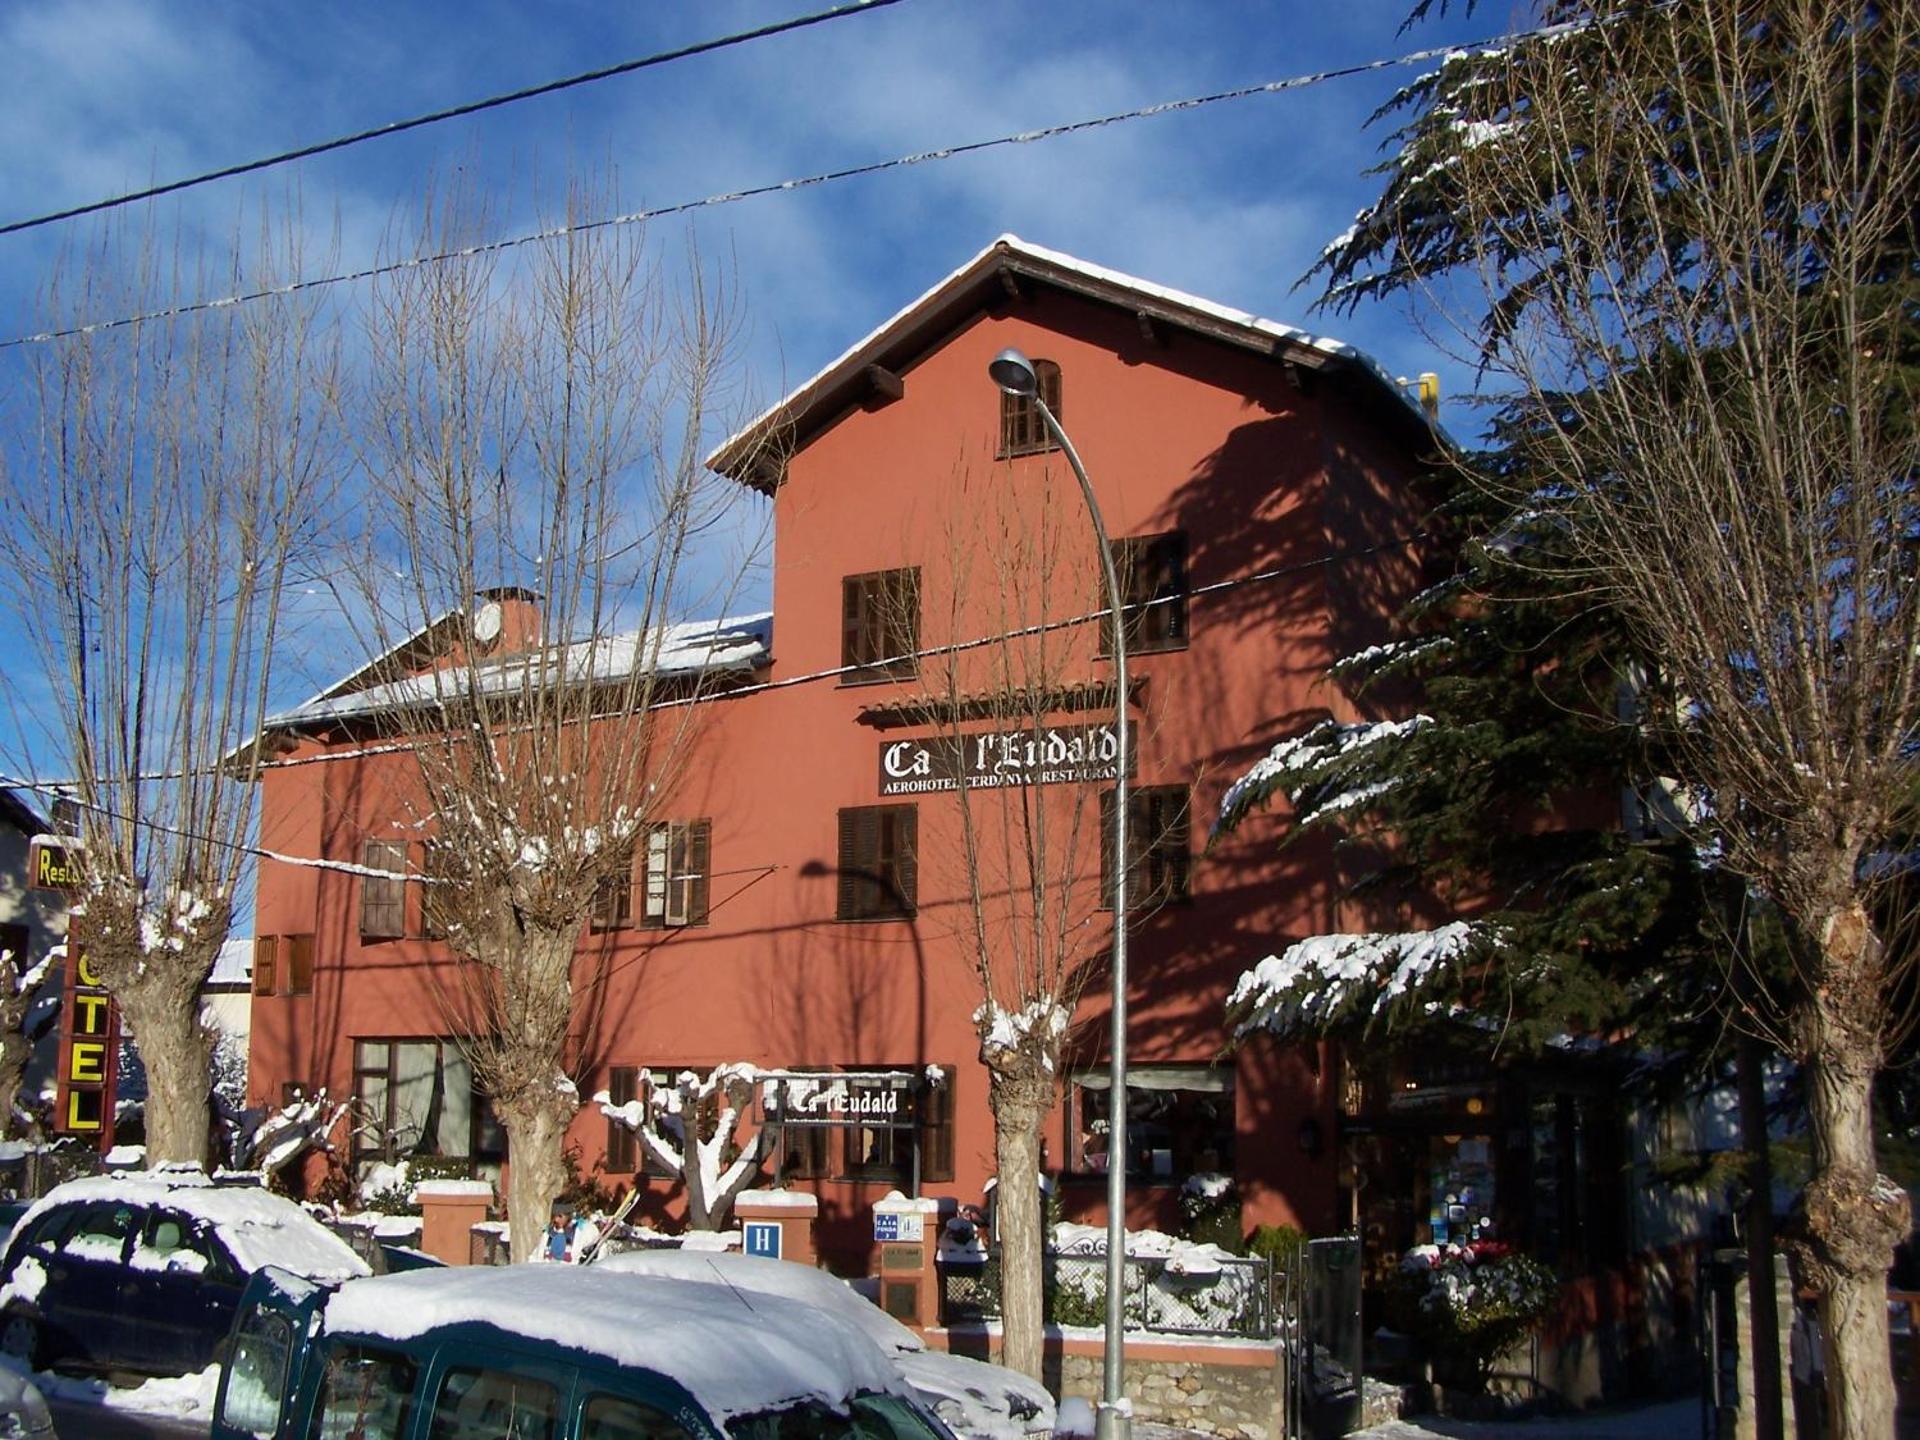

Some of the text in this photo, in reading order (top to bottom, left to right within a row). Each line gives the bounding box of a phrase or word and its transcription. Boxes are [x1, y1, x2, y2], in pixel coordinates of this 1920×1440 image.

[884, 742, 931, 778] Ca
[883, 777, 960, 795] AEROHOTEL
[1042, 766, 1117, 783] RESTAURAN
[68, 954, 108, 1130] OTEL
[755, 1228, 770, 1251] H
